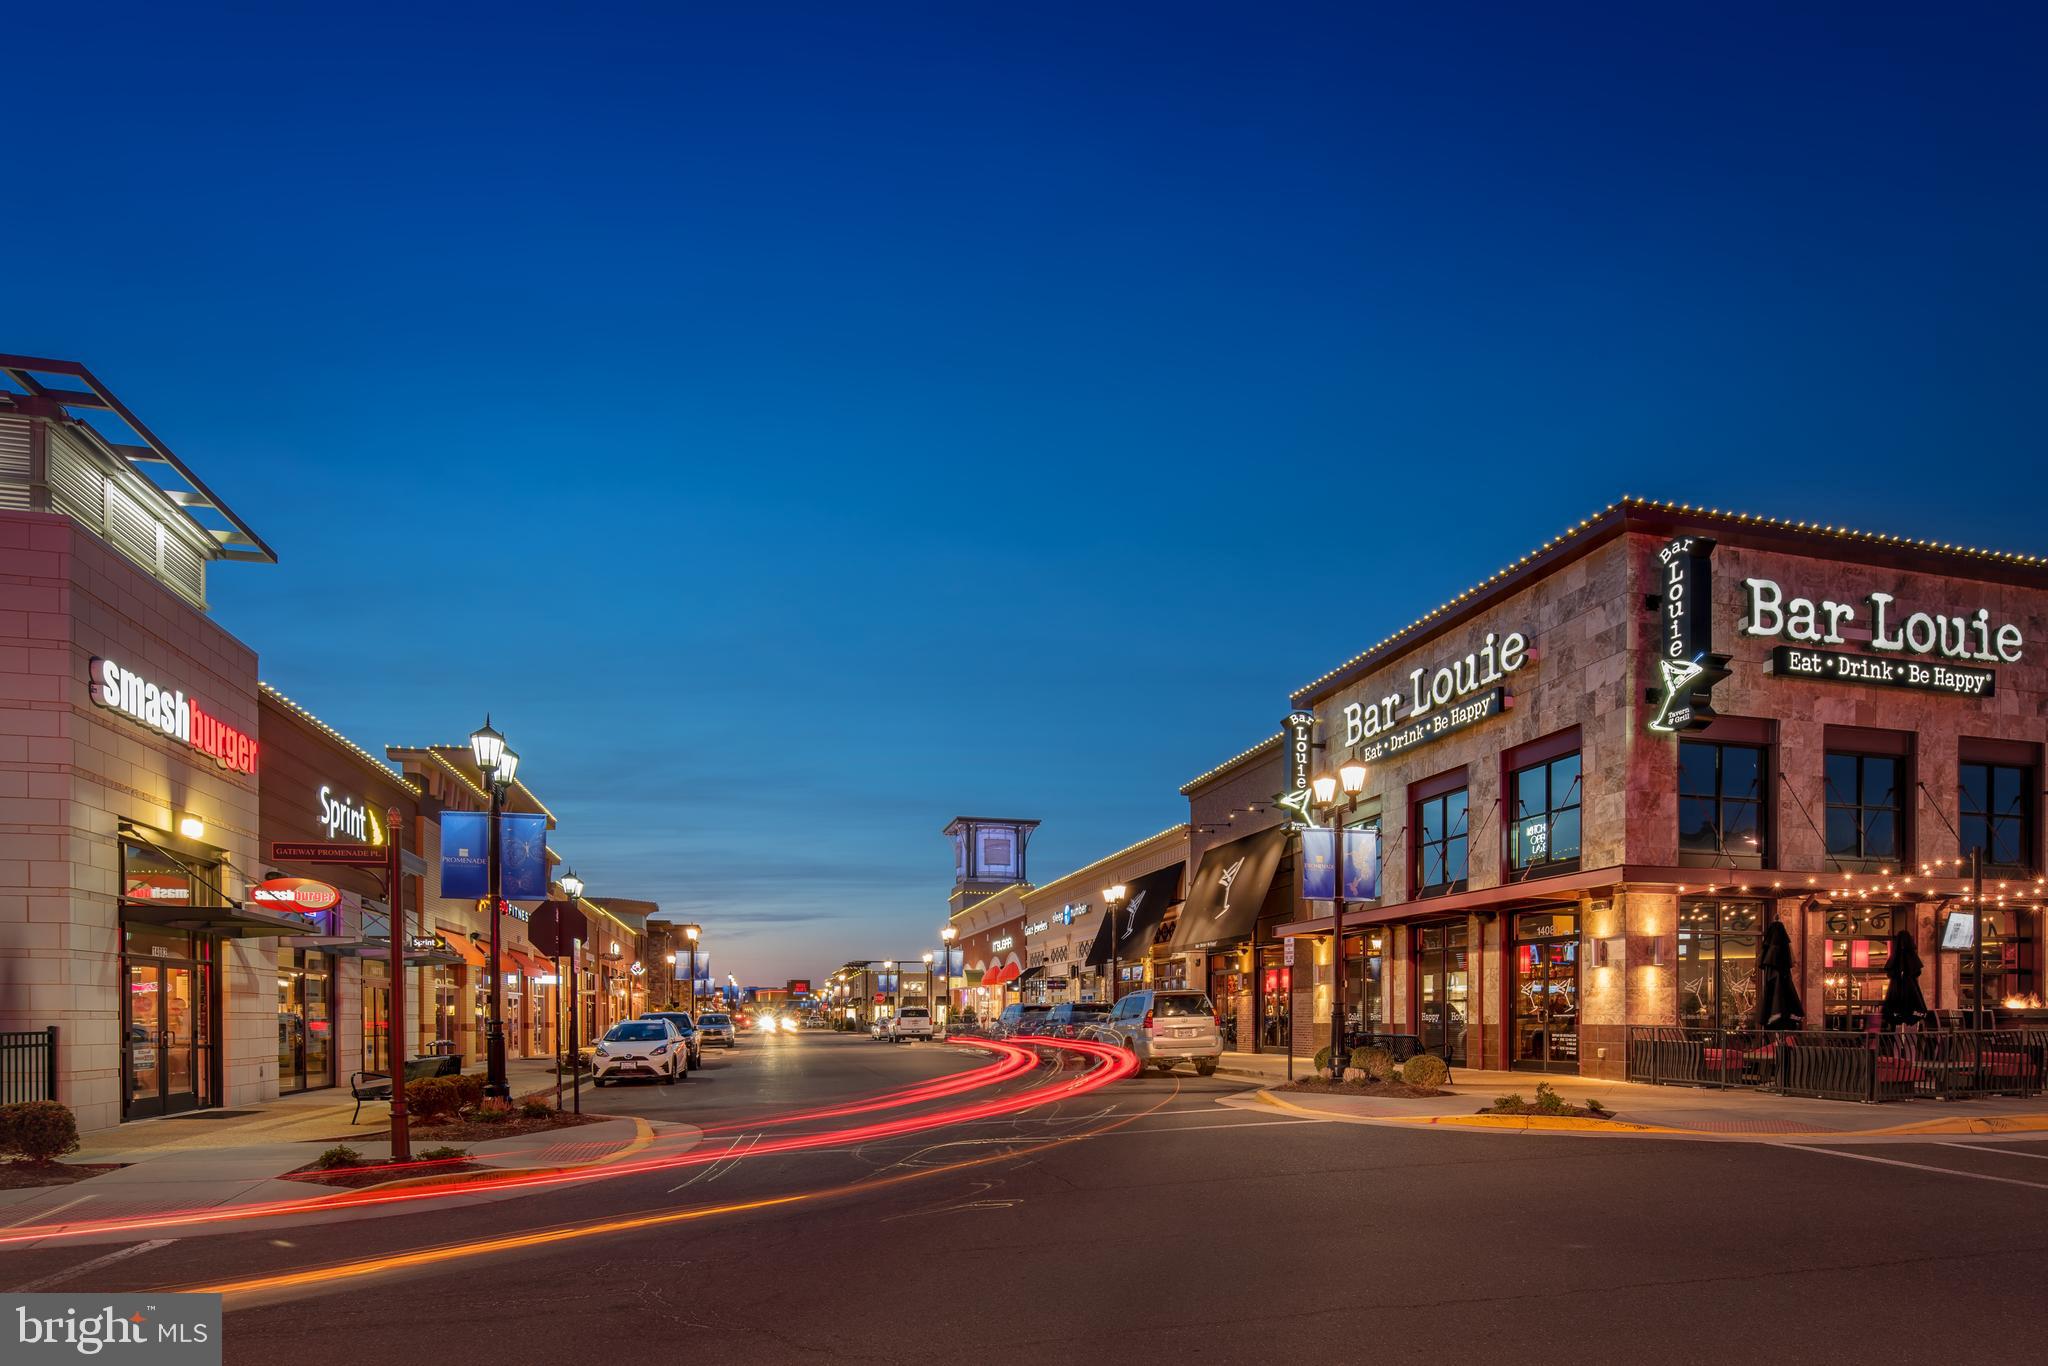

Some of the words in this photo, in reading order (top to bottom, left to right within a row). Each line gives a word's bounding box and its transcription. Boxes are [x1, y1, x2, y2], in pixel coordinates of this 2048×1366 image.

[1658, 538, 1694, 565] Bar
[1668, 560, 1685, 658] Louie
[1746, 577, 1855, 644] Bar
[1871, 592, 2023, 663] Louie
[1789, 651, 1822, 673] Eat
[1838, 656, 1893, 681] Drink
[1909, 664, 1930, 684] Be
[1343, 694, 1399, 748] Bar
[1410, 632, 1526, 718] Louie
[102, 659, 259, 775] smashburger
[1289, 713, 1315, 729] Bar
[1668, 707, 1690, 719] Tavern
[1364, 741, 1383, 762] Eat
[1390, 725, 1425, 752] Drink
[1433, 715, 1449, 734] Be
[1295, 726, 1307, 788] Louie
[320, 785, 367, 842] Sprint
[275, 848, 316, 856] GATEWAY
[317, 848, 369, 857] PROMENADE
[442, 856, 488, 865] PROMENADE
[255, 889, 335, 903] smashburger
[508, 903, 532, 923] FITNES
[413, 938, 436, 947] Sprint
[1421, 1012, 1440, 1023] Happy
